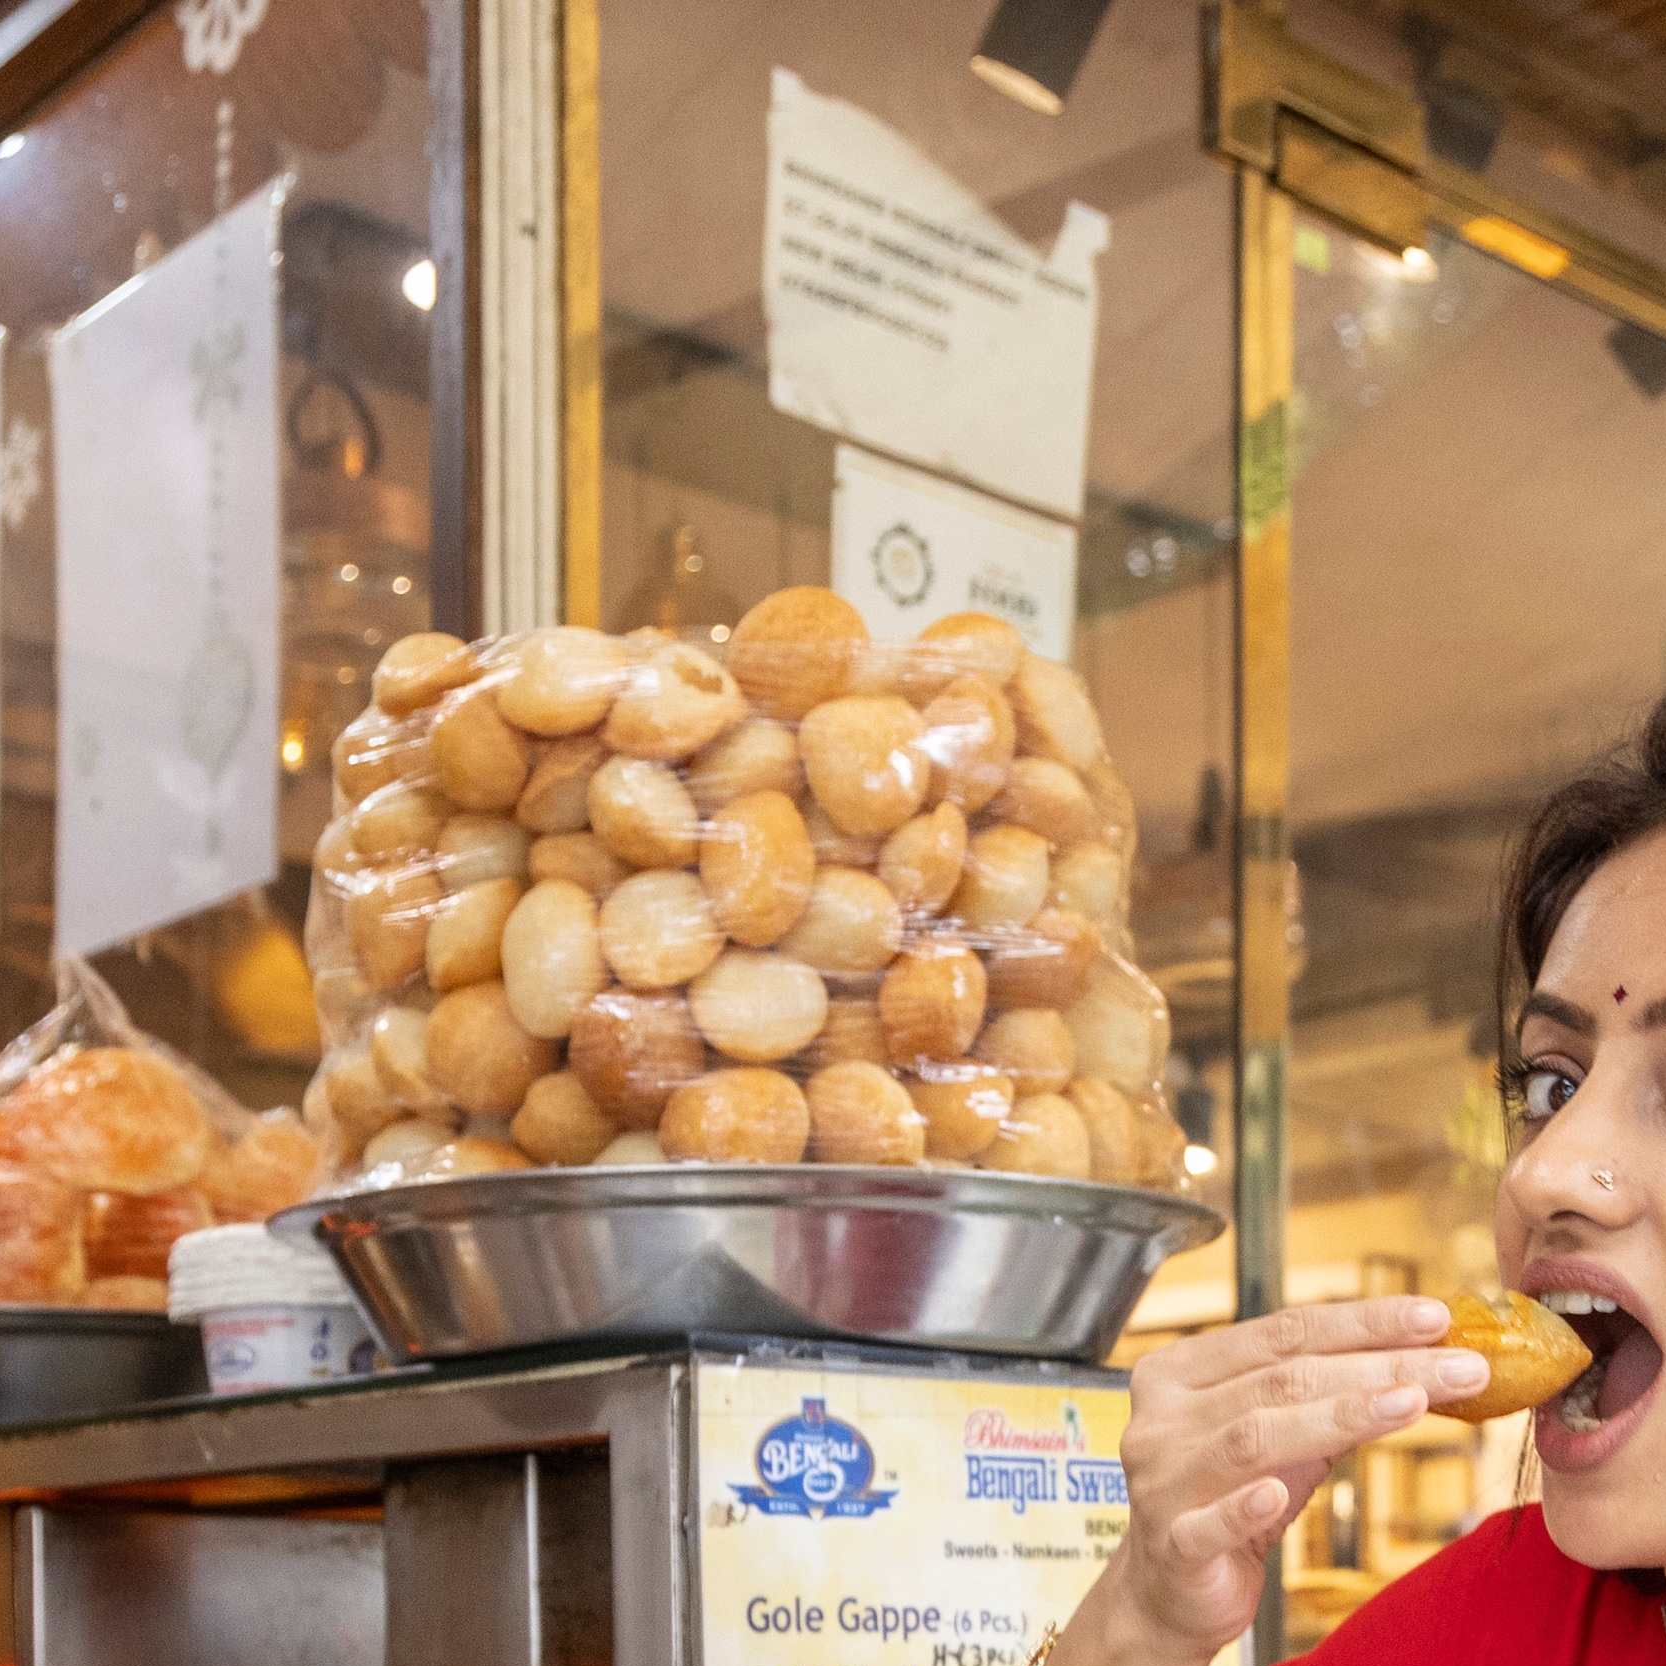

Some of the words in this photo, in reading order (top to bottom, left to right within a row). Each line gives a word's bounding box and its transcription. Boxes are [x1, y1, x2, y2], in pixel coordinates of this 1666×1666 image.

[965, 1454, 1057, 1514] Bengali
[747, 1597, 824, 1633] Gole
[838, 1597, 941, 1641] Gappe
